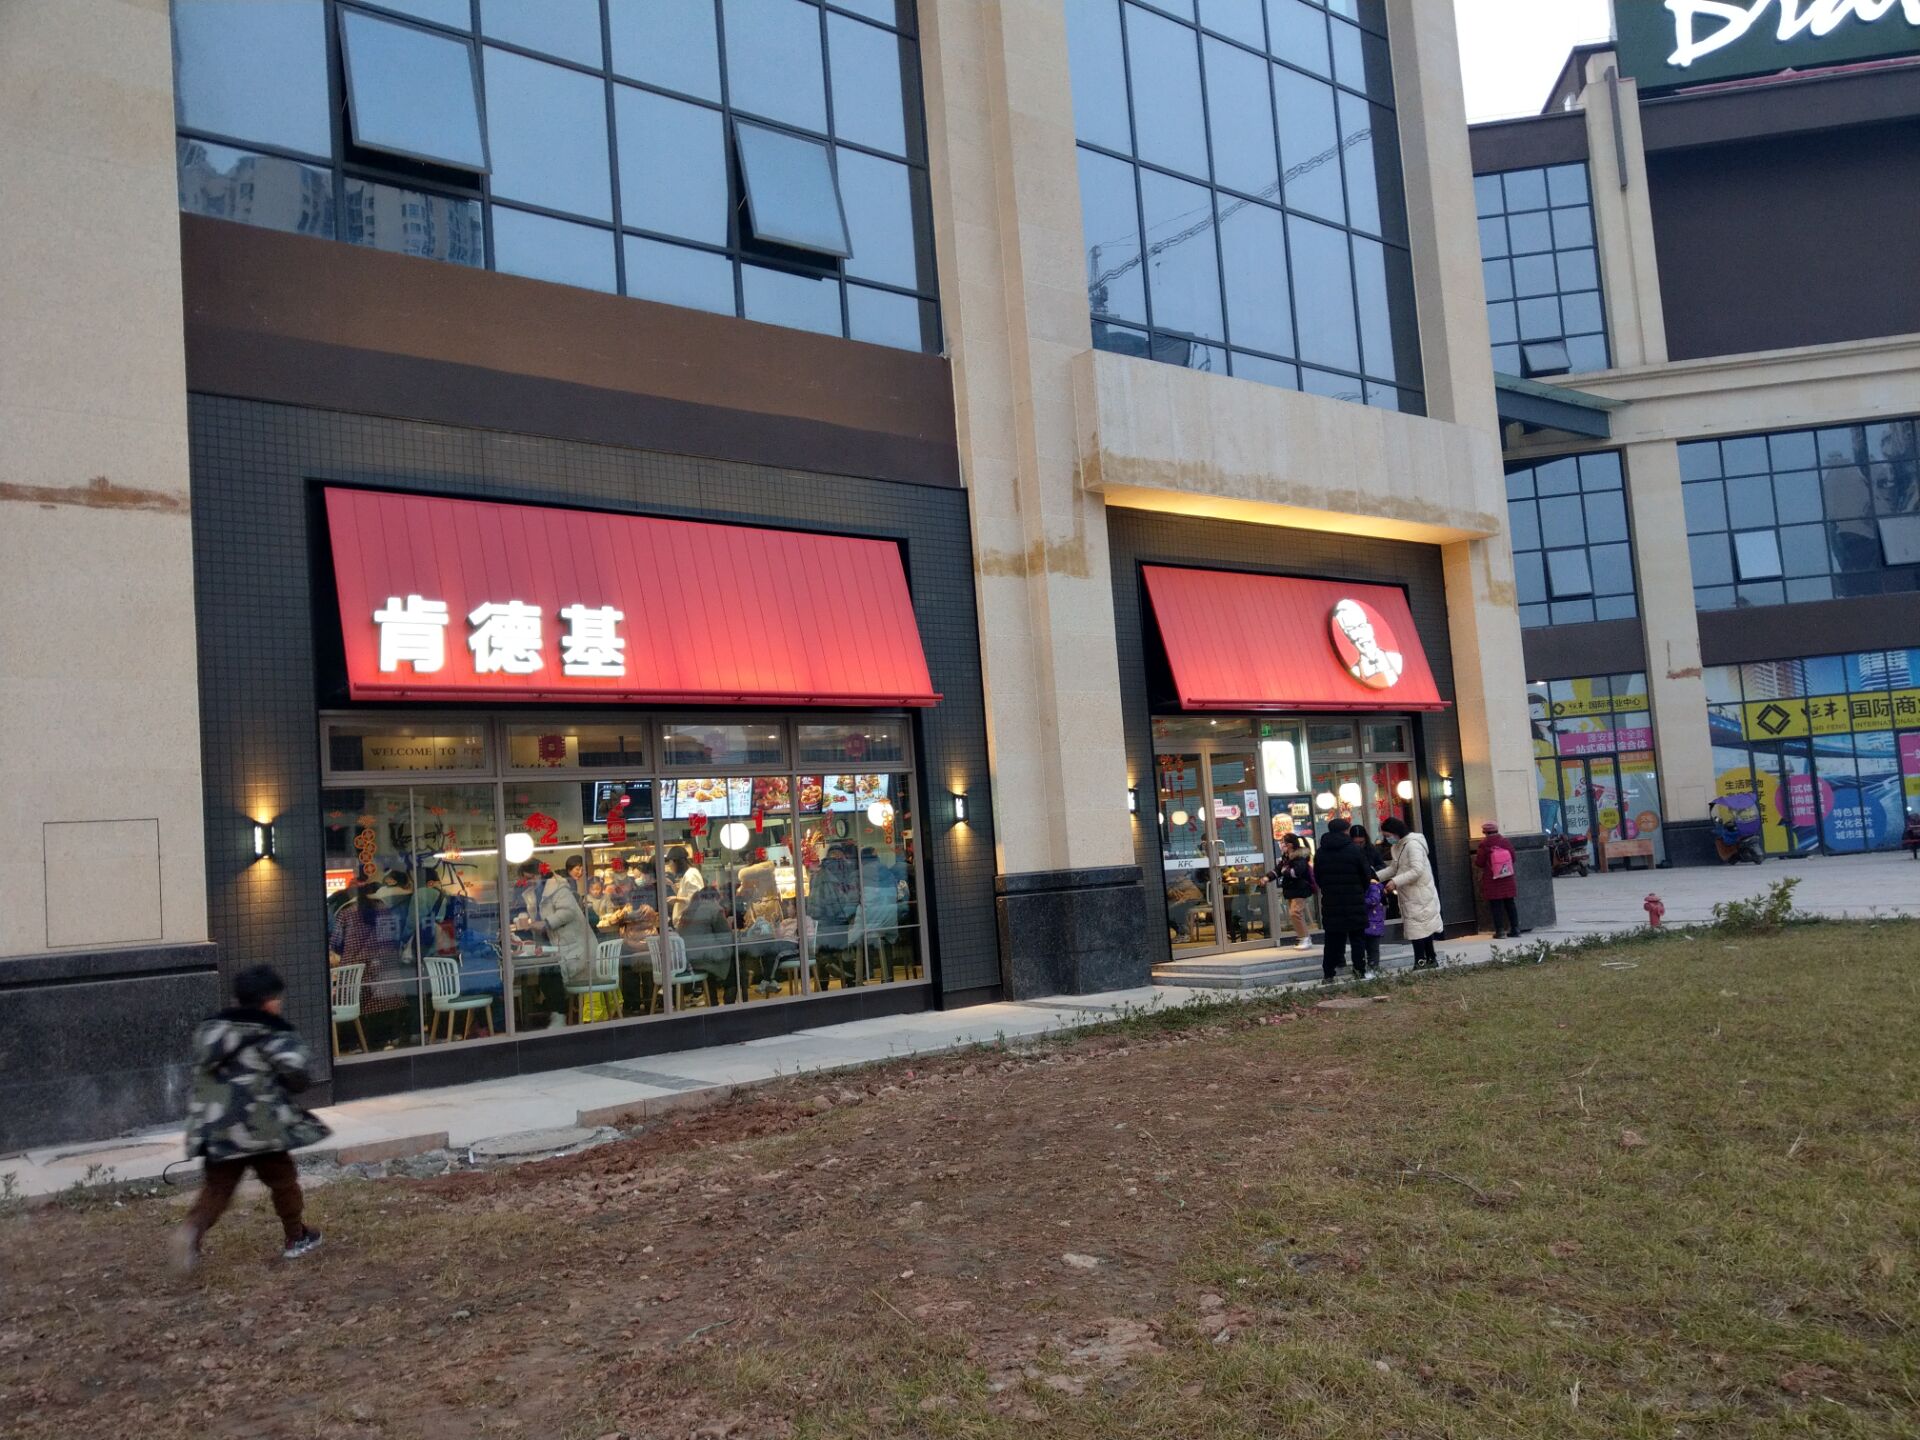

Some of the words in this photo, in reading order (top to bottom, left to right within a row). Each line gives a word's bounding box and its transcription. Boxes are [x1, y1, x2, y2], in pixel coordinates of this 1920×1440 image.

[373, 595, 626, 676] 肯德基
[370, 747, 432, 756] WELCOME
[439, 747, 456, 756] TO
[1834, 818, 1873, 829] 文化名片
[1835, 829, 1875, 840] 城市生活
[1178, 860, 1193, 868] KFC
[1234, 856, 1249, 864] KFC
